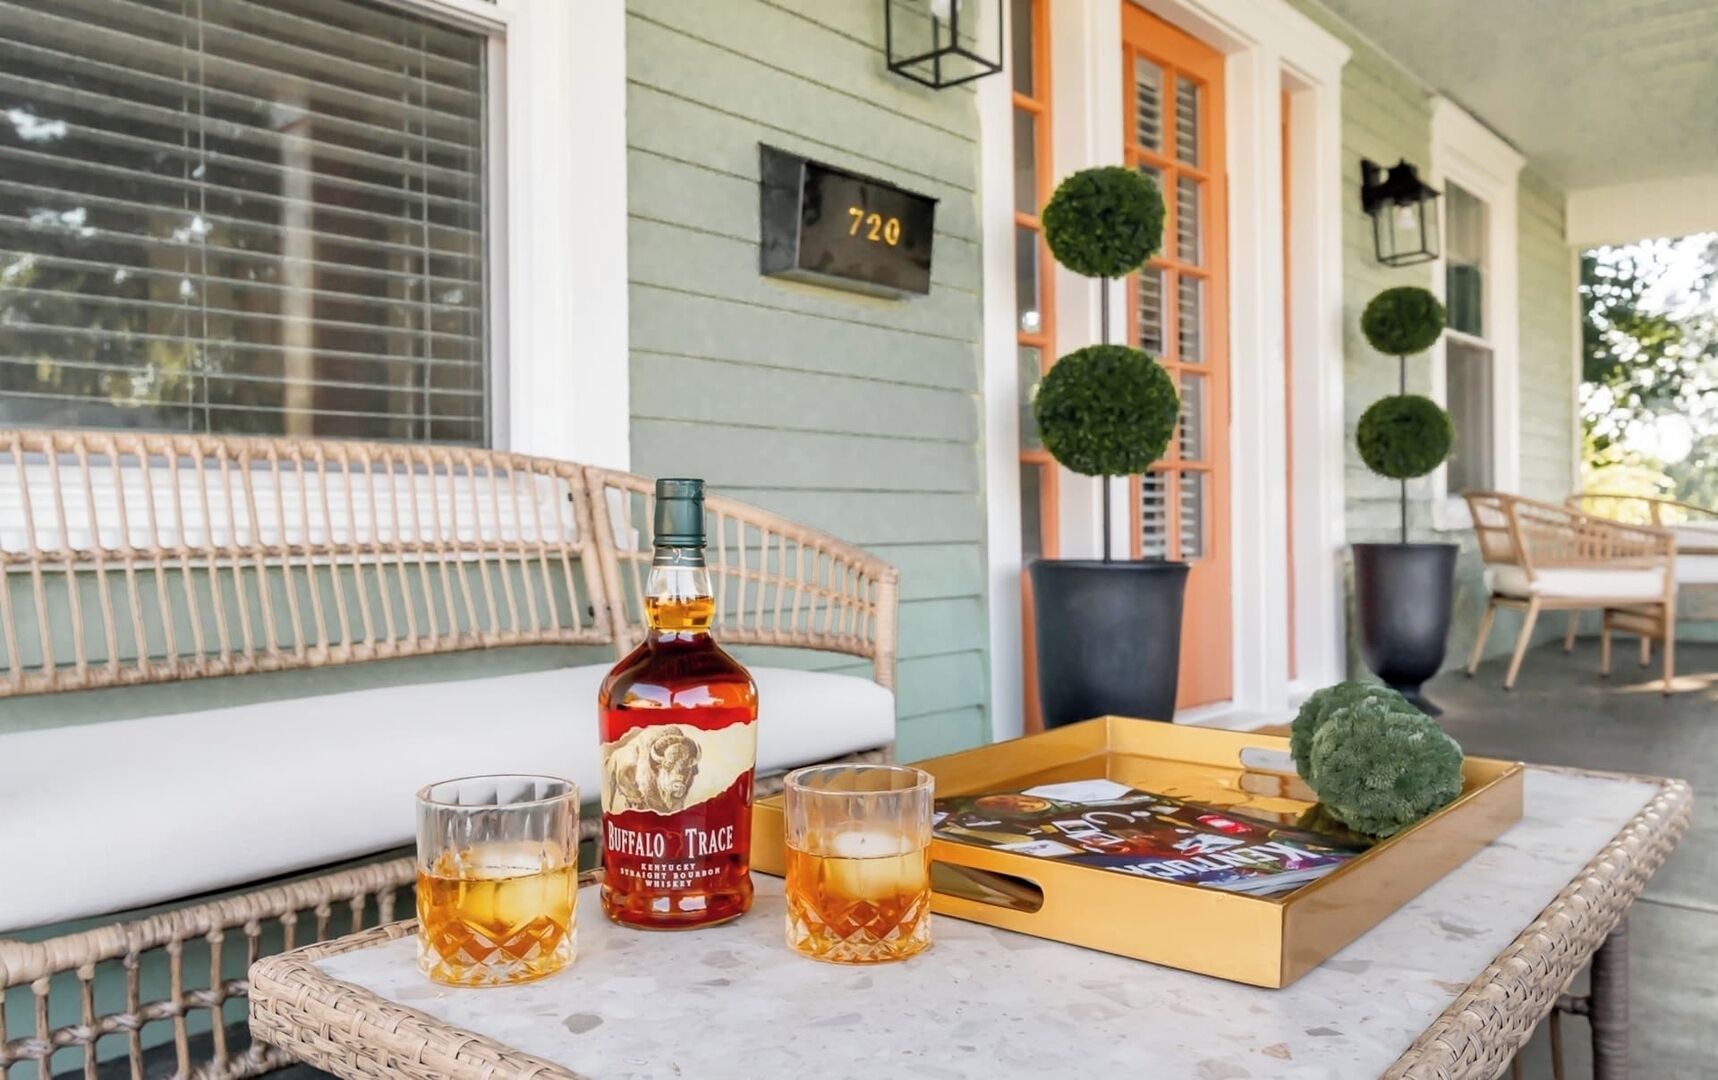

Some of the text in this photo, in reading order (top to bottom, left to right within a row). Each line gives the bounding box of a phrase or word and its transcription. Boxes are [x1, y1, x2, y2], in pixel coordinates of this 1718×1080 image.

[849, 207, 901, 246] 720
[607, 821, 734, 858] BUFFALO TRACE
[641, 863, 696, 871] KENTUCKY
[1104, 841, 1322, 880] KENTUCK
[620, 867, 721, 880] STRAIGHT BOURBON
[645, 879, 692, 888] WHISKEY
